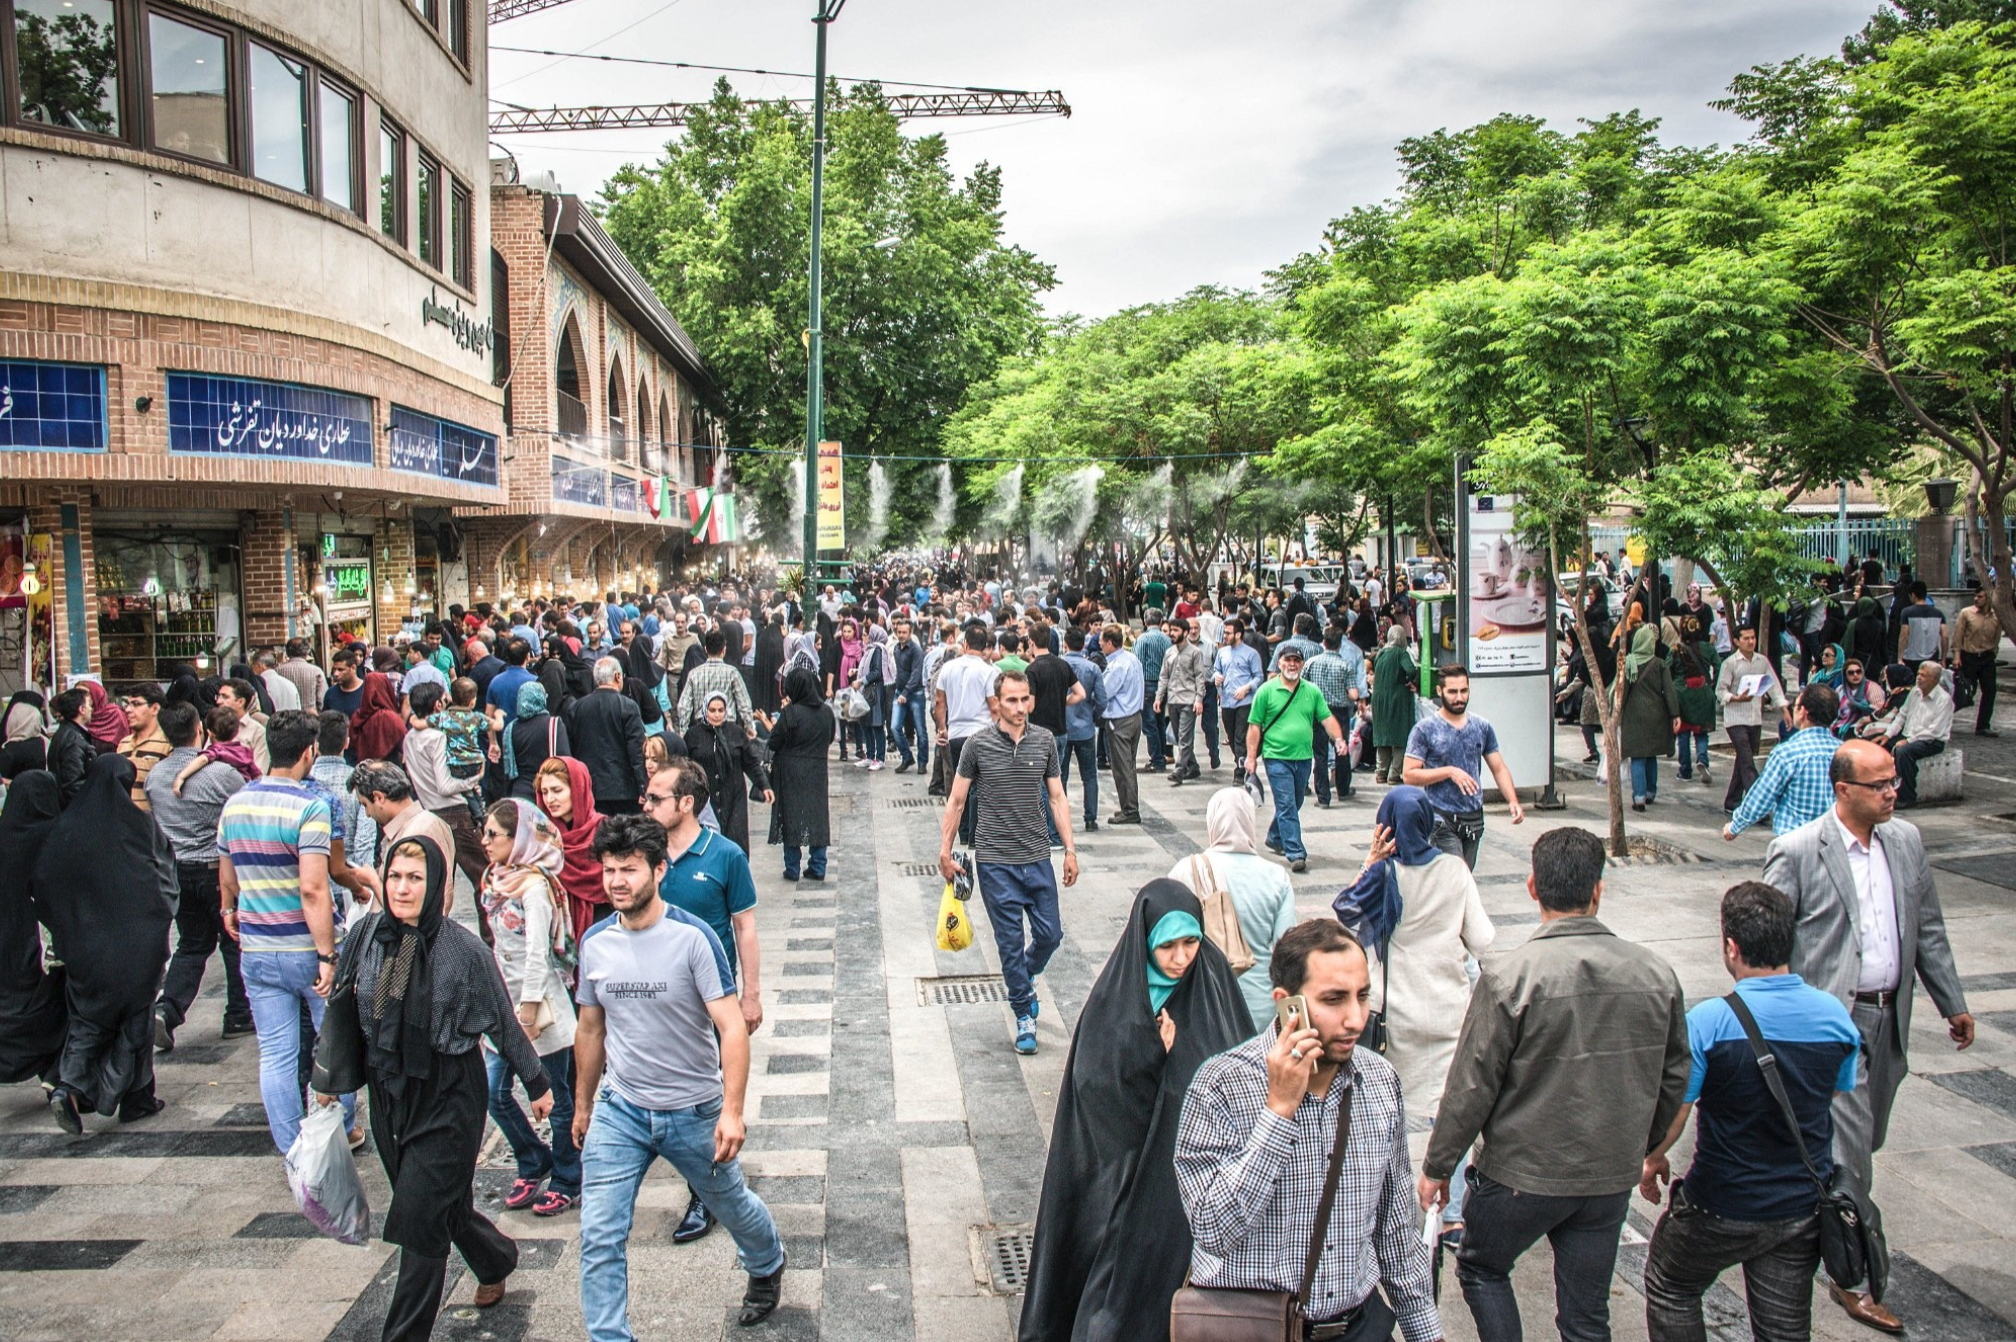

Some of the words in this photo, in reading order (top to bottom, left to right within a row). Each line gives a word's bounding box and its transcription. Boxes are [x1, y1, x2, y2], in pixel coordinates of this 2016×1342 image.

[218, 399, 262, 447] تفرشی
[318, 416, 350, 454] عطاری
[614, 991, 639, 1000] SINCE
